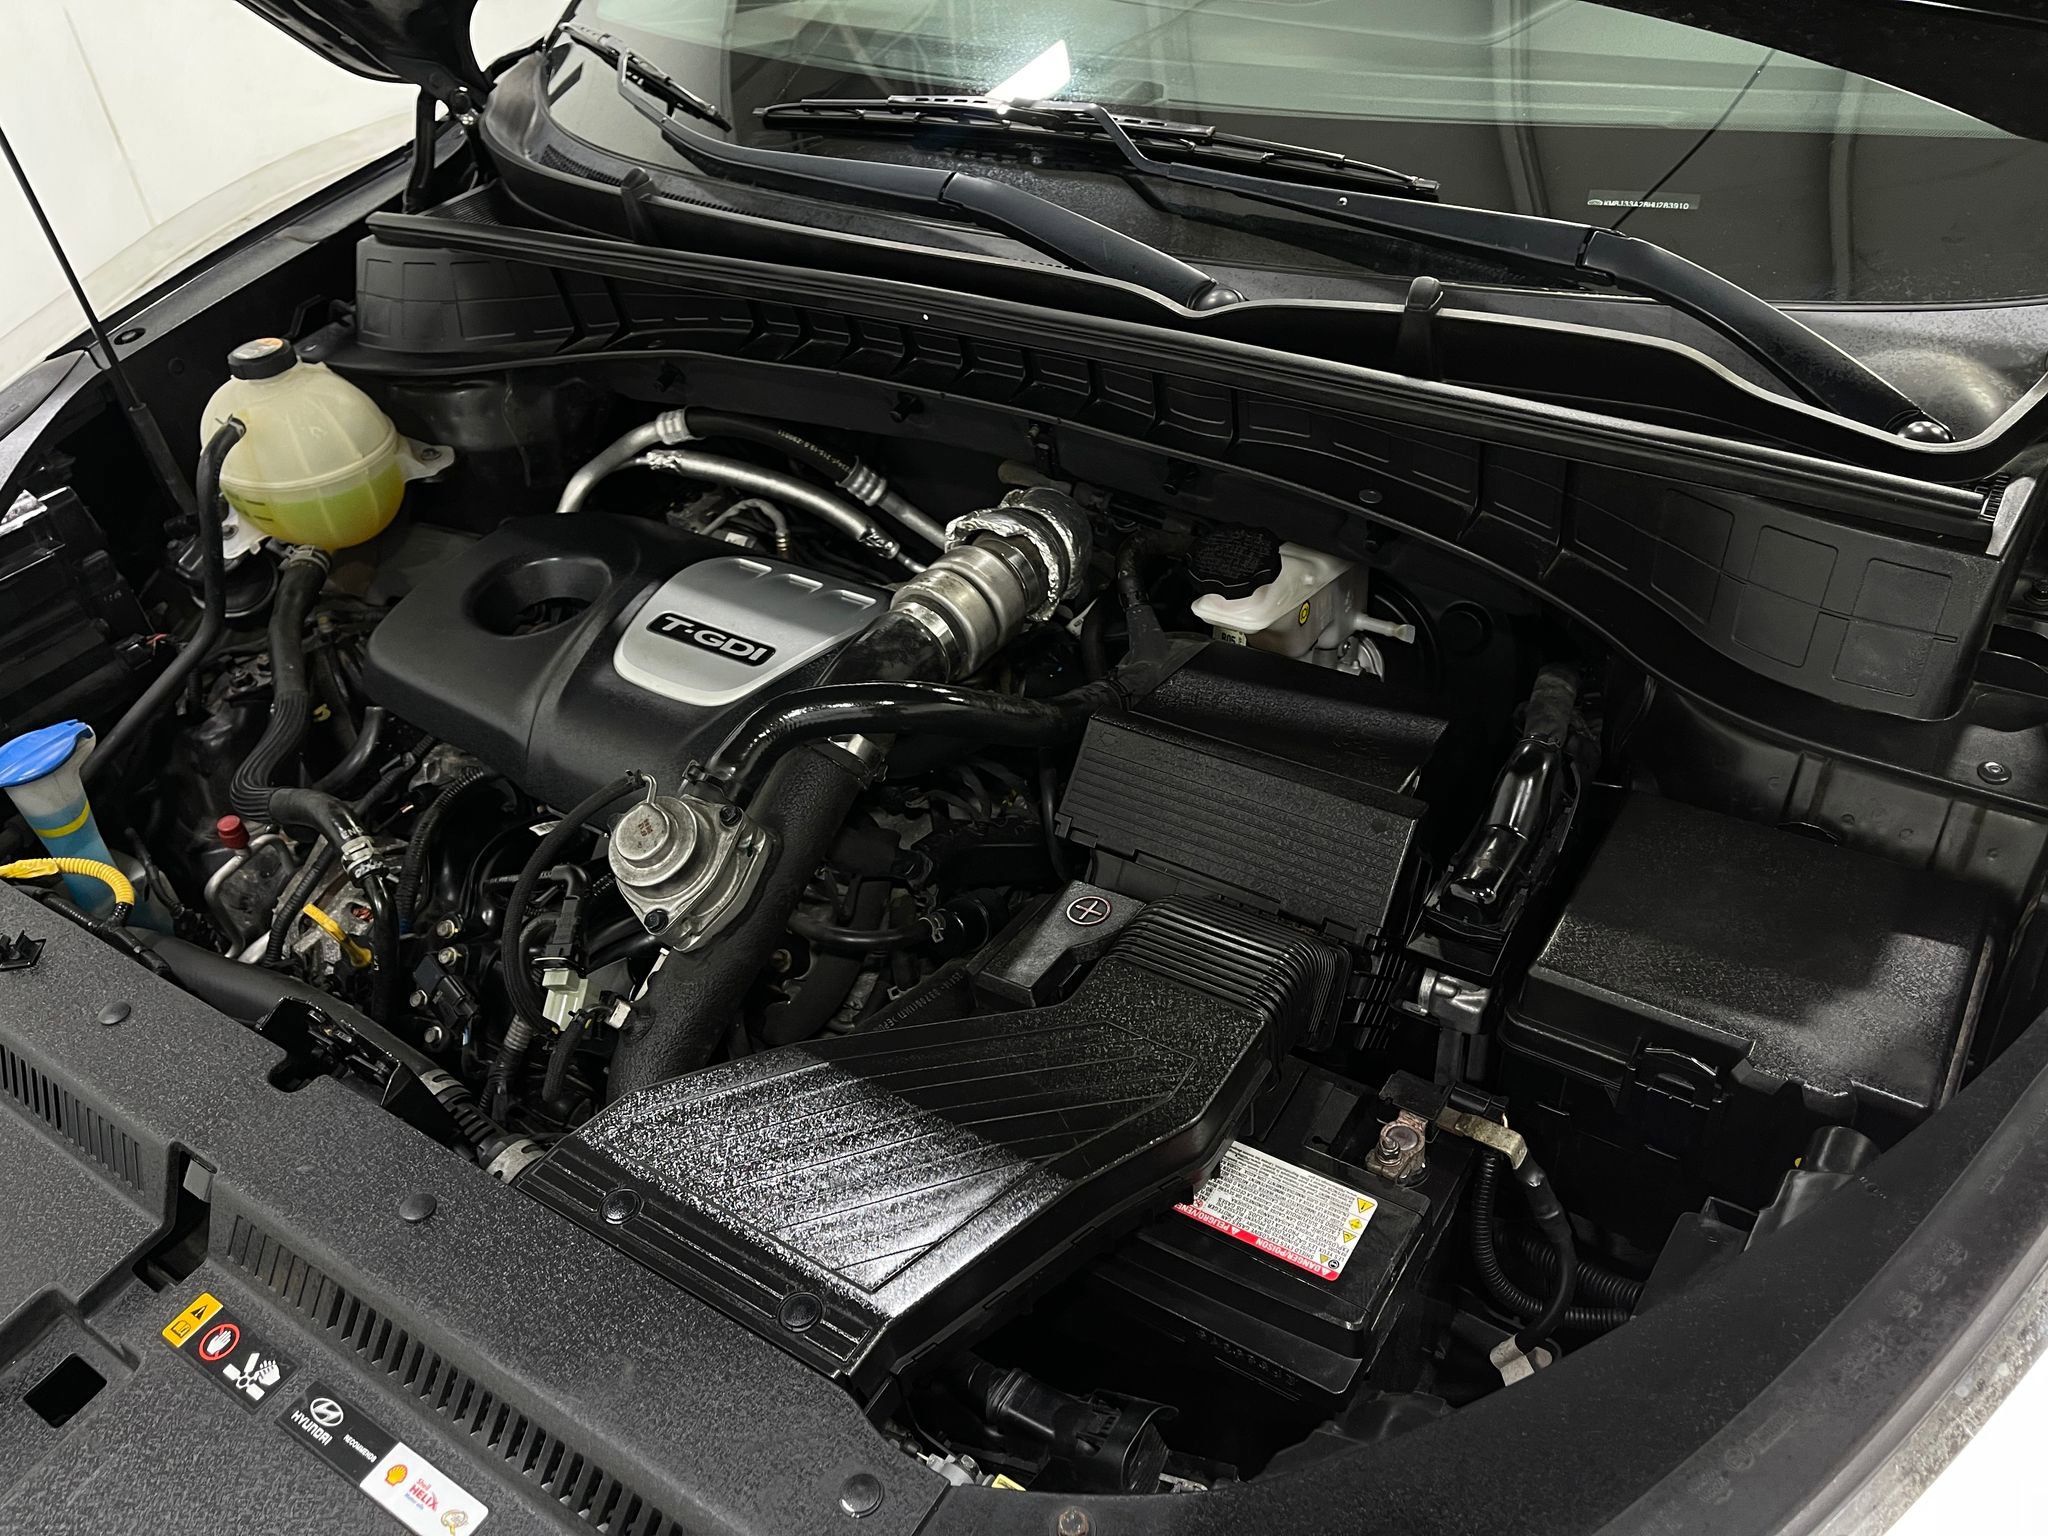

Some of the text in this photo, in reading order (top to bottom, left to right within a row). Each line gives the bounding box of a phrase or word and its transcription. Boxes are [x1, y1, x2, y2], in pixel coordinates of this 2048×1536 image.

[1173, 1201, 1321, 1272] DANGER/POISON PELIGRO/VENE
[291, 1410, 333, 1447] HYUNDAI
[343, 1434, 378, 1463] RECOMMENDS
[409, 1484, 440, 1512] HELIX
[417, 1477, 431, 1491] Shell
